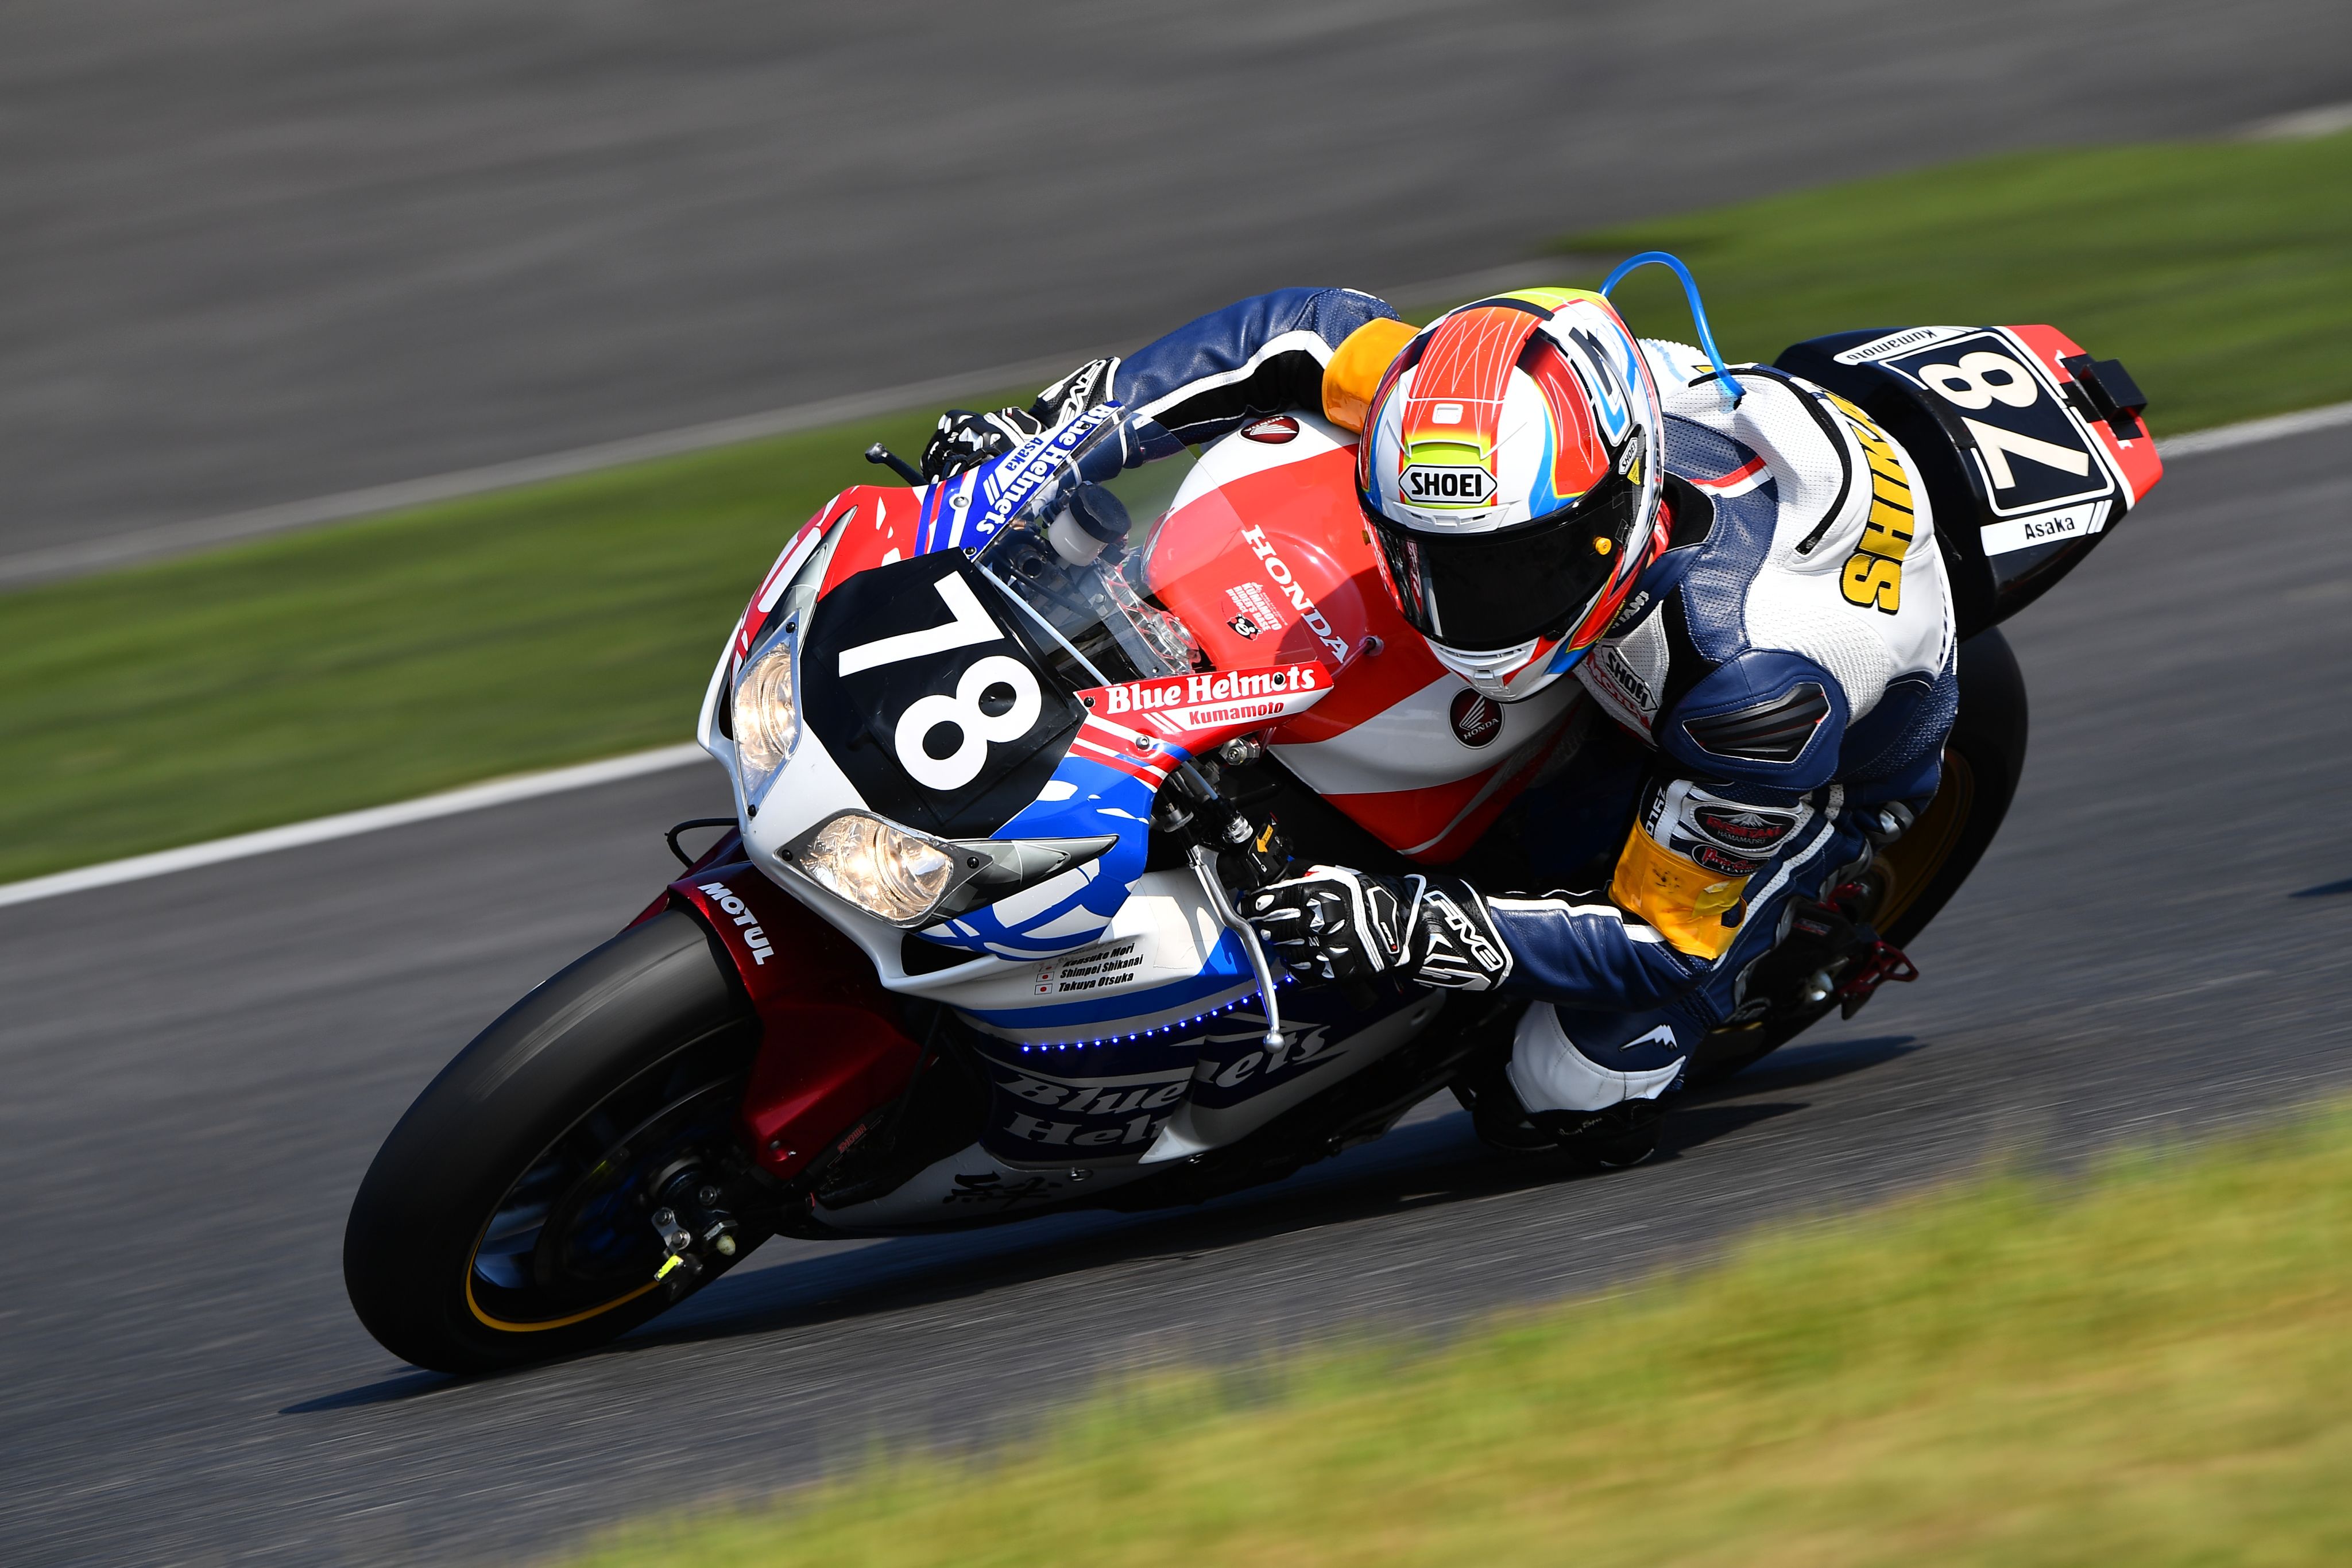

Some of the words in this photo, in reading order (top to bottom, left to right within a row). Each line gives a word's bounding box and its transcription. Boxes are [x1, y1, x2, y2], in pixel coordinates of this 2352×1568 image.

[1846, 328, 1937, 362] Kumamoto
[1058, 404, 1119, 446] Blue
[1243, 416, 1285, 432] HONDA
[1918, 350, 2089, 490] 78
[1004, 436, 1045, 471] Asaka
[1622, 441, 1636, 471] SHOEI
[976, 444, 1071, 535] Helmets
[1410, 473, 1482, 497] SHOEI
[2024, 516, 2076, 541] Asaka
[1225, 588, 1249, 614] project
[1241, 524, 1350, 664] HONDA
[1241, 582, 1282, 630] KUMAMOTO
[1252, 611, 1272, 632] BASE
[838, 570, 1042, 791] 78
[1105, 683, 1182, 715] Blue
[1186, 665, 1316, 705] Helmets
[1606, 651, 1649, 708] SHOEI
[1189, 702, 1285, 726] Kumamoto
[1463, 718, 1500, 740] HONDA
[1717, 829, 1766, 845] HAMAMATSU
[697, 882, 775, 965] MOTUL
[1060, 958, 1101, 979] Shimpei
[1101, 954, 1144, 973] Shikanai
[1110, 943, 1135, 958] Mori
[1058, 978, 1096, 993] Takuya
[1097, 972, 1135, 988] Otsuka
[995, 1074, 1191, 1116] Blue
